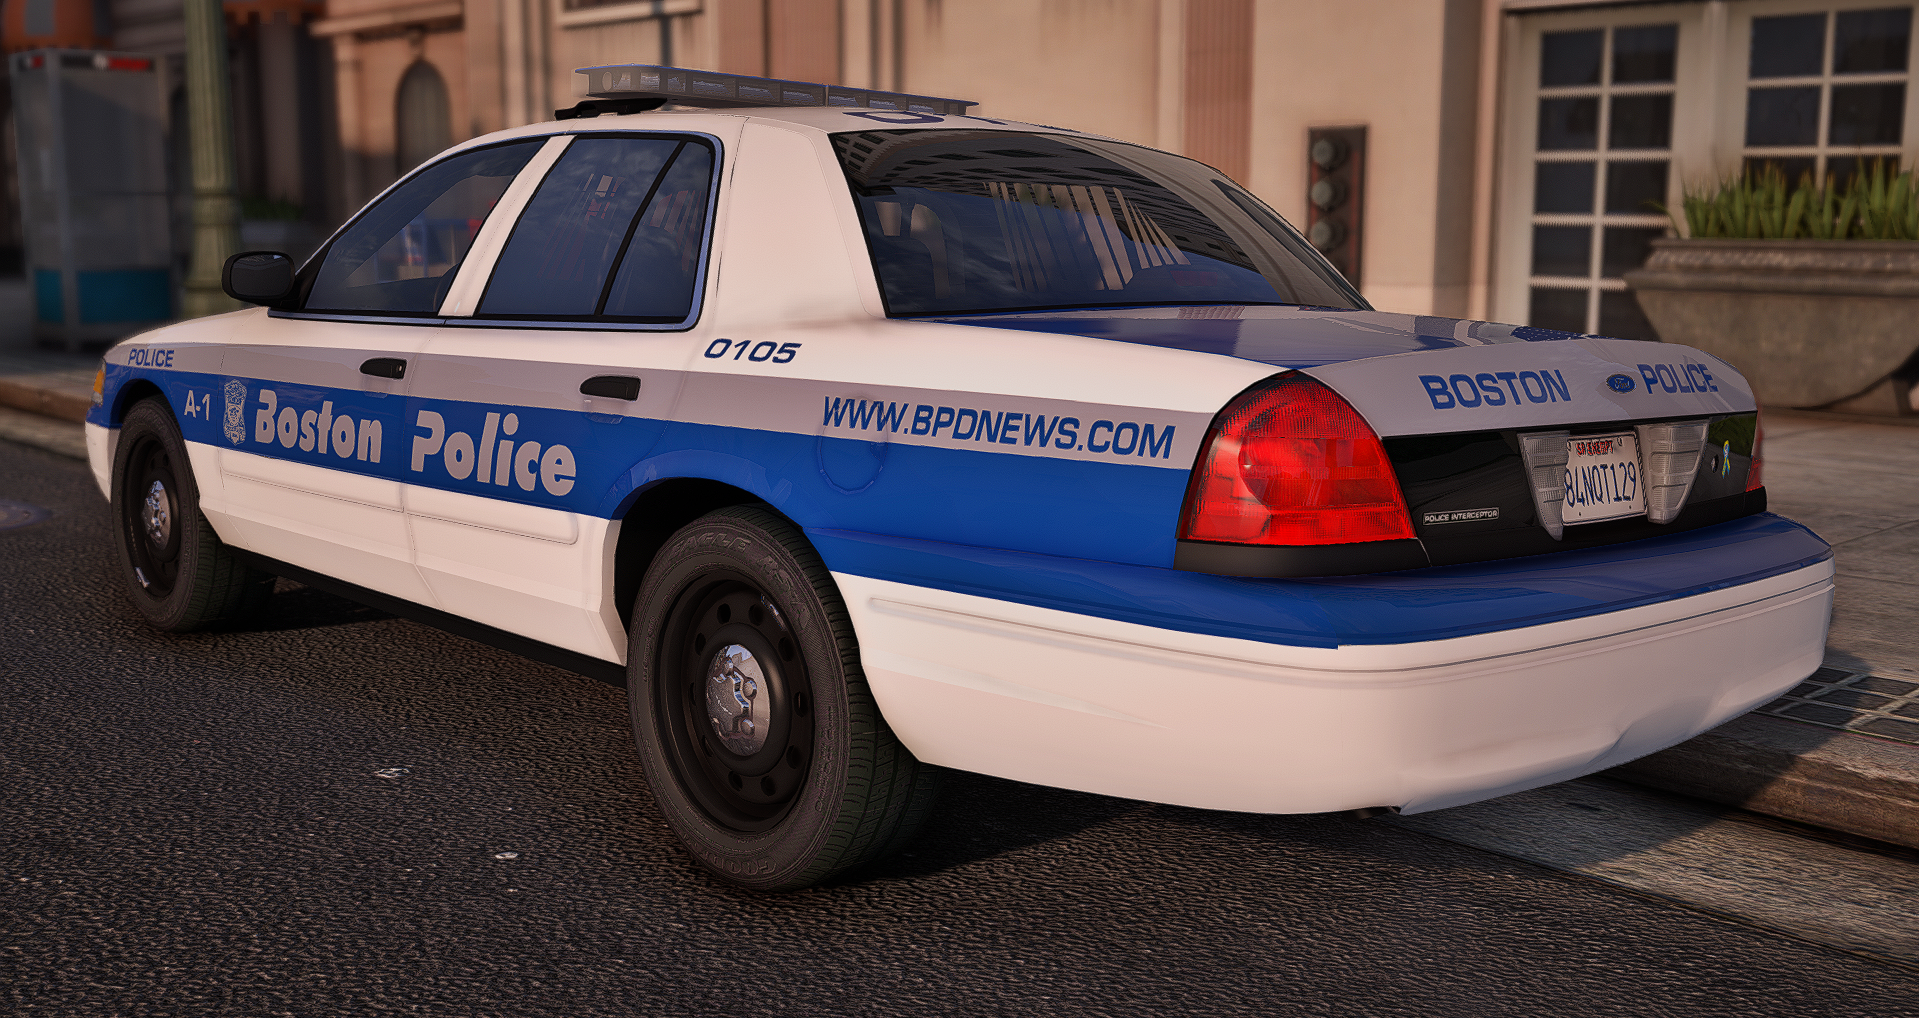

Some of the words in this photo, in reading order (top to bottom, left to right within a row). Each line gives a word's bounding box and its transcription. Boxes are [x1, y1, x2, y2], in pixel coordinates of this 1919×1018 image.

[128, 348, 175, 368] POLICE
[703, 338, 802, 364] 0105
[1418, 369, 1572, 409] BOSTON
[1637, 364, 1719, 394] POLICE
[184, 389, 211, 421] A-1
[254, 389, 383, 463] Boston
[411, 409, 577, 496] Police
[823, 396, 1176, 459] WWW.BPDNEWS.COM
[1424, 514, 1450, 522] POLICE
[1451, 510, 1498, 520] INTERCEPTOR
